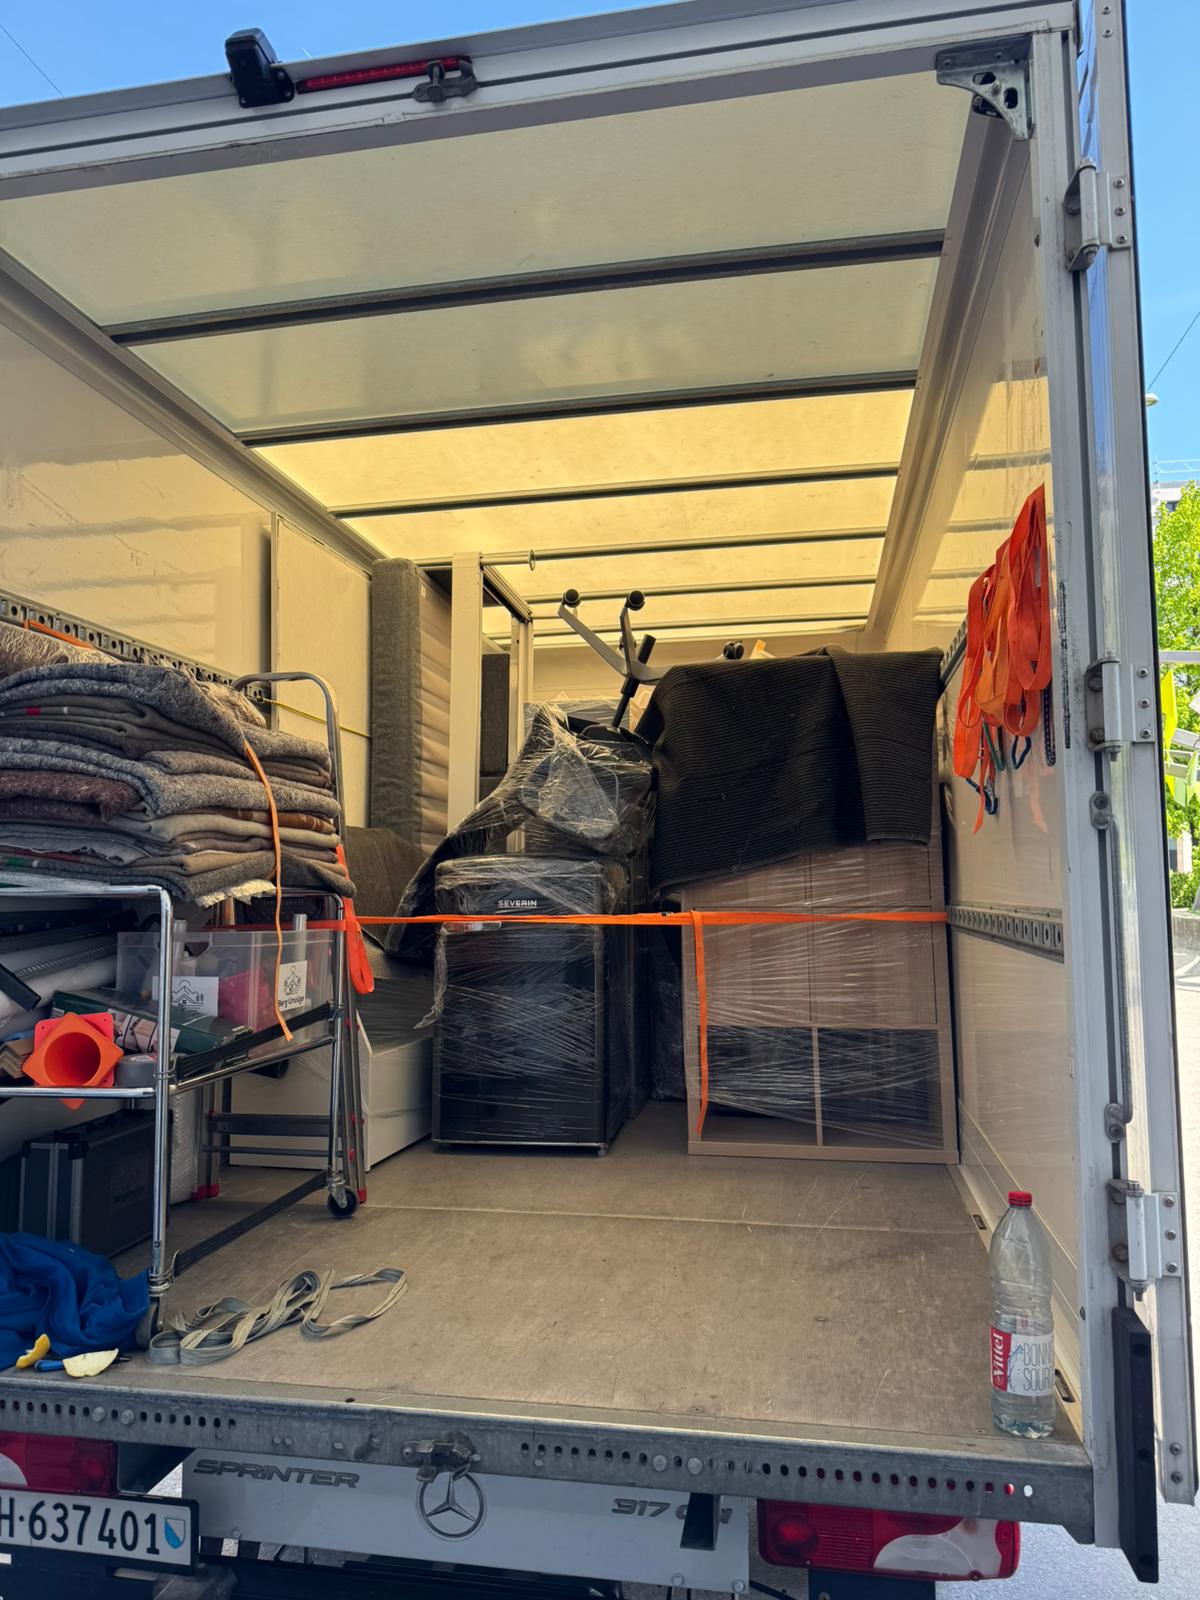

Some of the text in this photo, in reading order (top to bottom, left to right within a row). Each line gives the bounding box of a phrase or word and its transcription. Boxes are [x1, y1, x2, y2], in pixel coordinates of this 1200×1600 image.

[498, 899, 537, 909] SEVERIN
[992, 1332, 1005, 1376] Vittel
[192, 1458, 361, 1489] SPRINTER
[611, 1498, 671, 1518] 317
